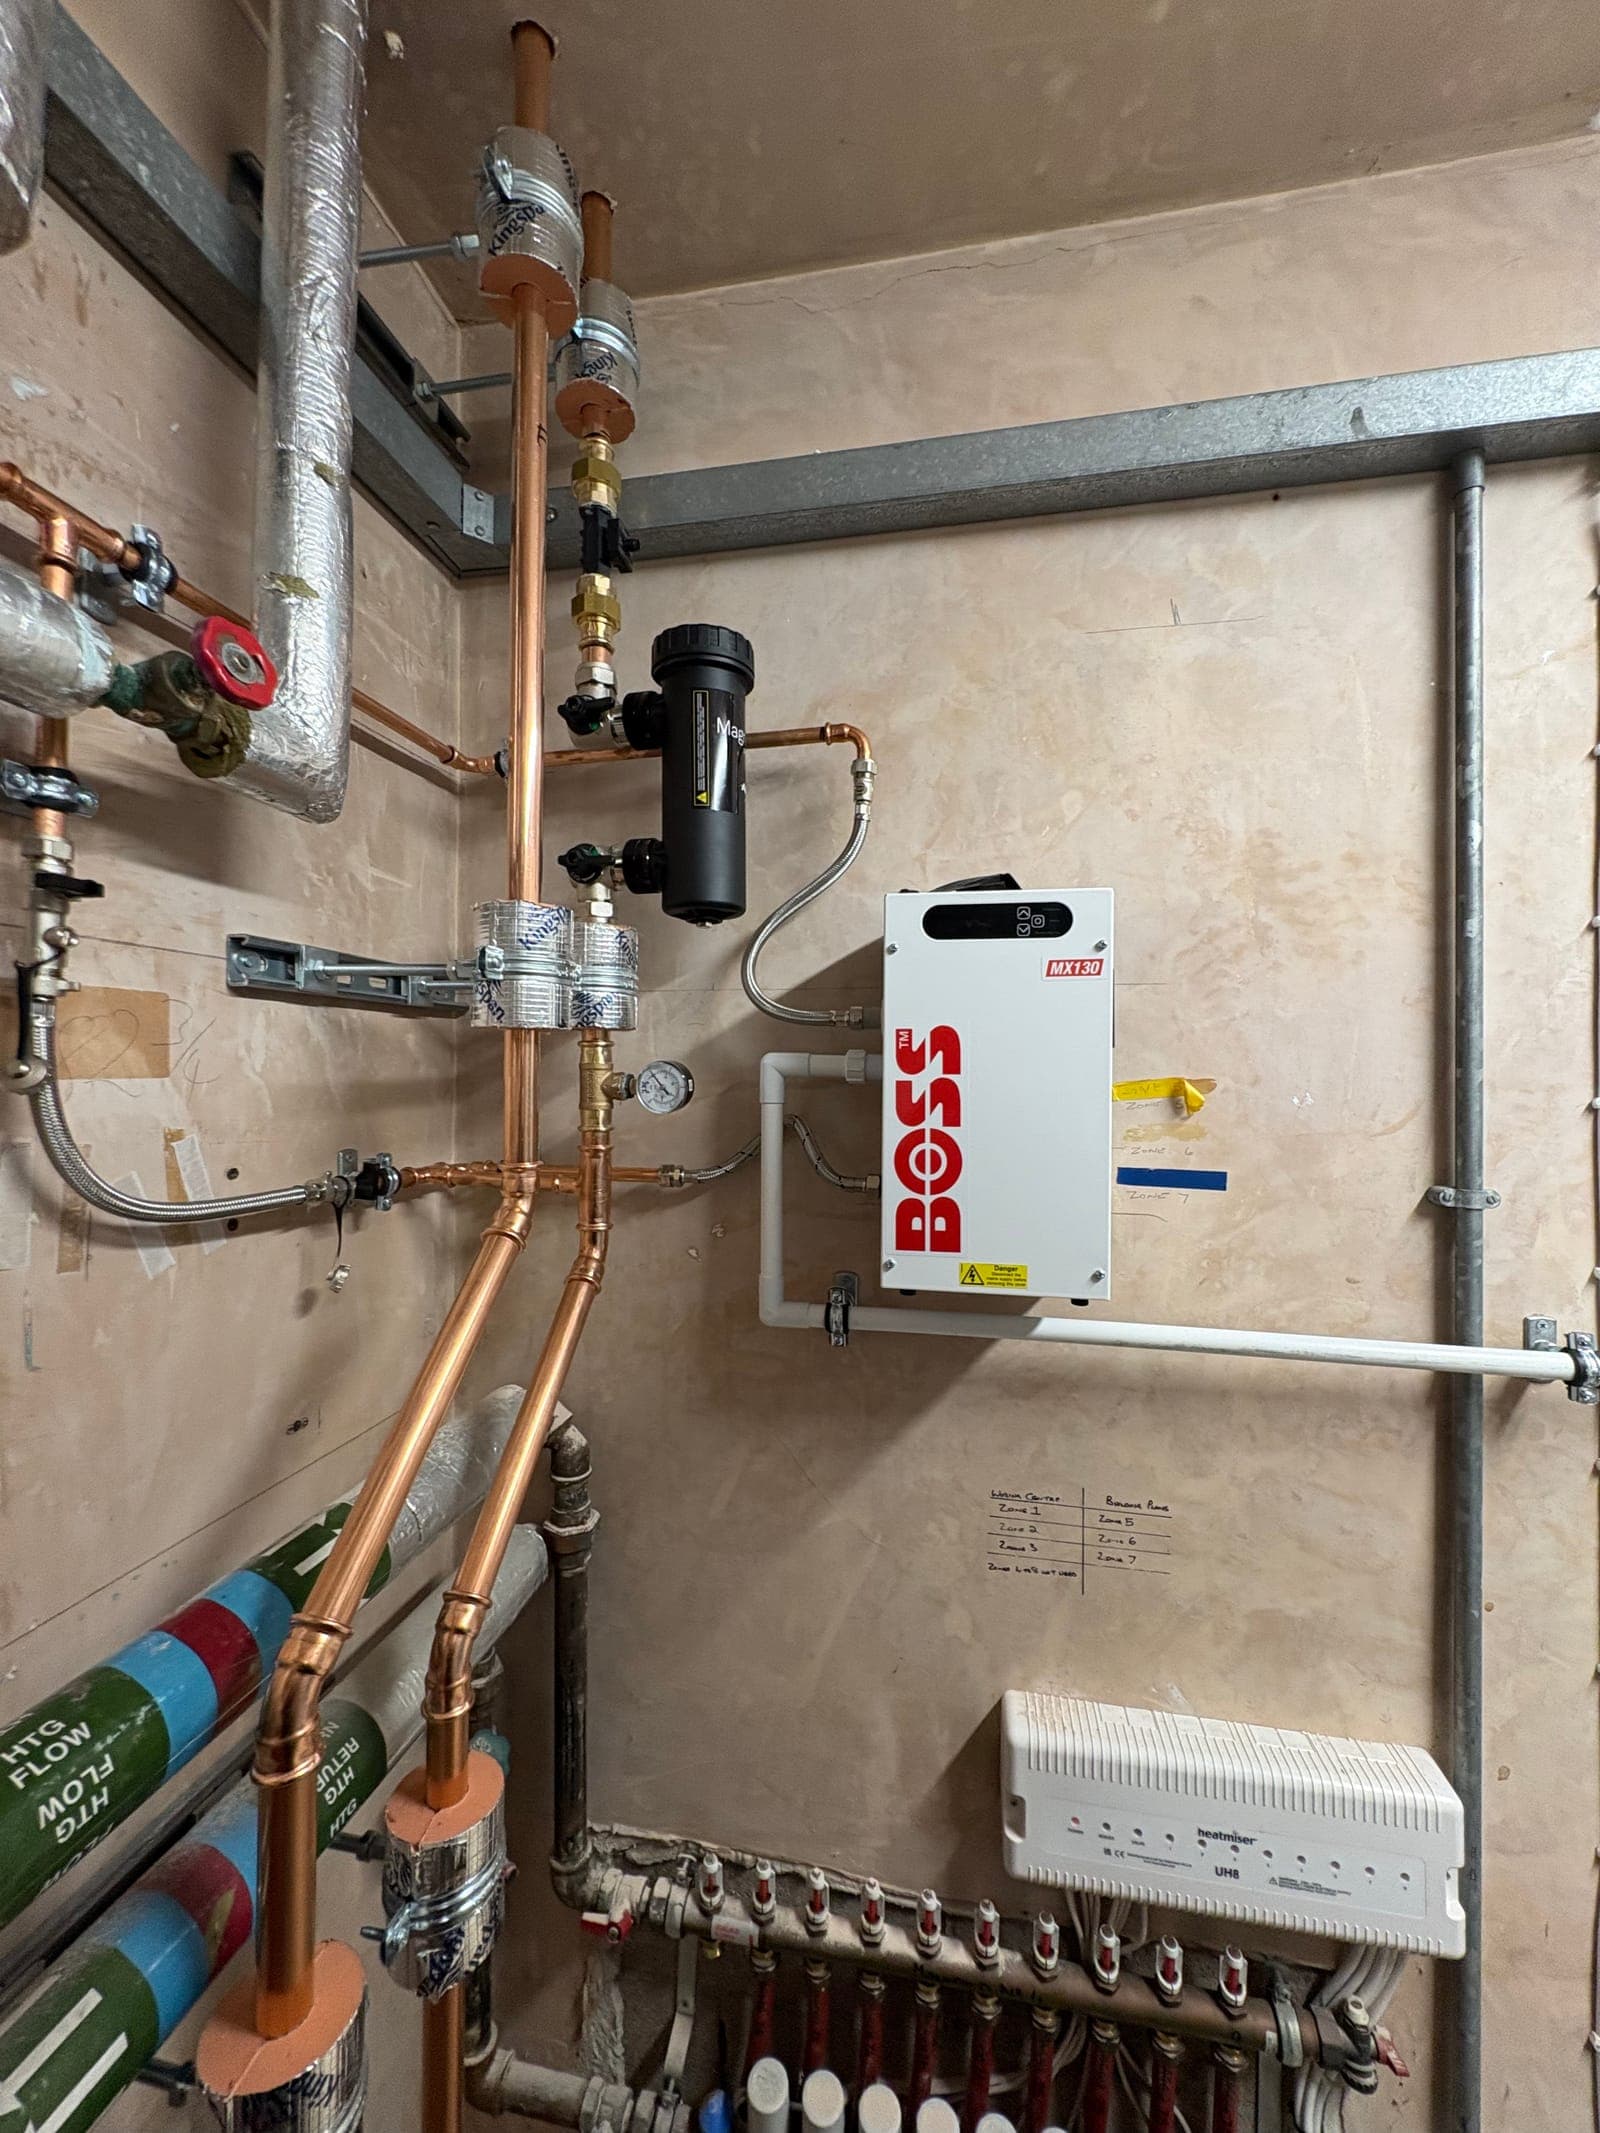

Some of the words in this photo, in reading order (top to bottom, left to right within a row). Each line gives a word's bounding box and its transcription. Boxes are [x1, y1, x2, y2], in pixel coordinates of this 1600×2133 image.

[488, 203, 546, 256] Kingspa
[716, 716, 746, 747] Mag
[518, 907, 570, 951] Kingsp
[1050, 961, 1100, 976] MX130
[899, 1031, 910, 1049] TM
[894, 1025, 963, 1253] BOSS
[1184, 1147, 1194, 1156] 6
[1178, 1193, 1189, 1204] 7
[1030, 1506, 1041, 1516] 1
[1124, 1517, 1134, 1527] 5
[1029, 1525, 1040, 1535] 2
[1128, 1536, 1137, 1545] 6
[1029, 1543, 1038, 1552] 3
[1128, 1554, 1137, 1564] 7
[0, 1719, 67, 1764] HTG
[8, 1721, 92, 1790] FLOW
[317, 1736, 360, 1792] RETUR
[38, 1753, 114, 1830] FLOW
[324, 1766, 355, 1805] HTG
[56, 1787, 110, 1844] HTG
[330, 1798, 358, 1838] HTG
[1197, 1827, 1255, 1846] heatmiser
